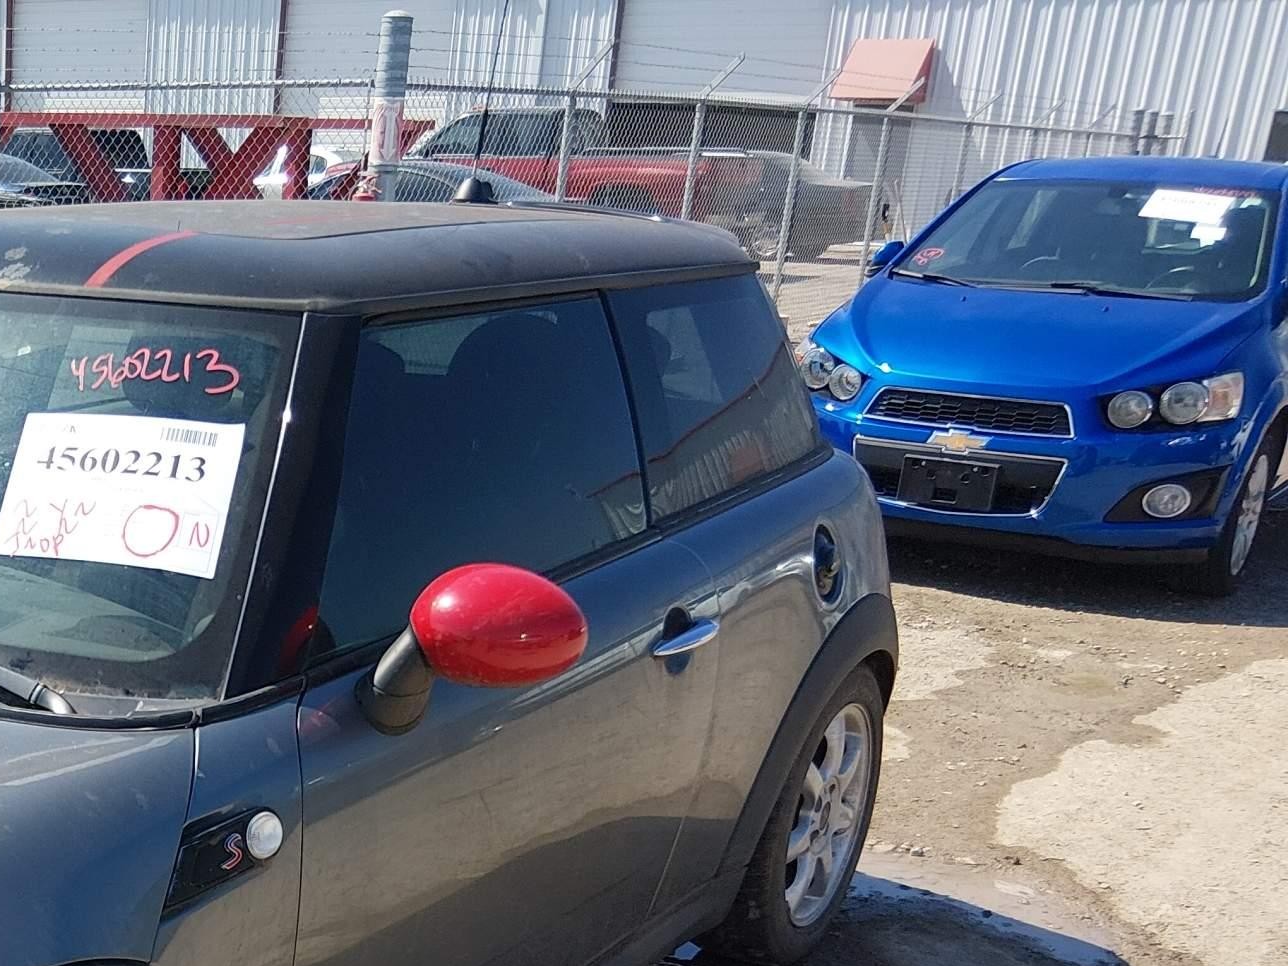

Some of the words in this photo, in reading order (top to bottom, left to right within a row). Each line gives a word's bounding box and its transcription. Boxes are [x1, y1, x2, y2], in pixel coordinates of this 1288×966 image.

[70, 347, 240, 395] 45602213
[37, 446, 207, 483] 45602213
[221, 832, 243, 871] S
